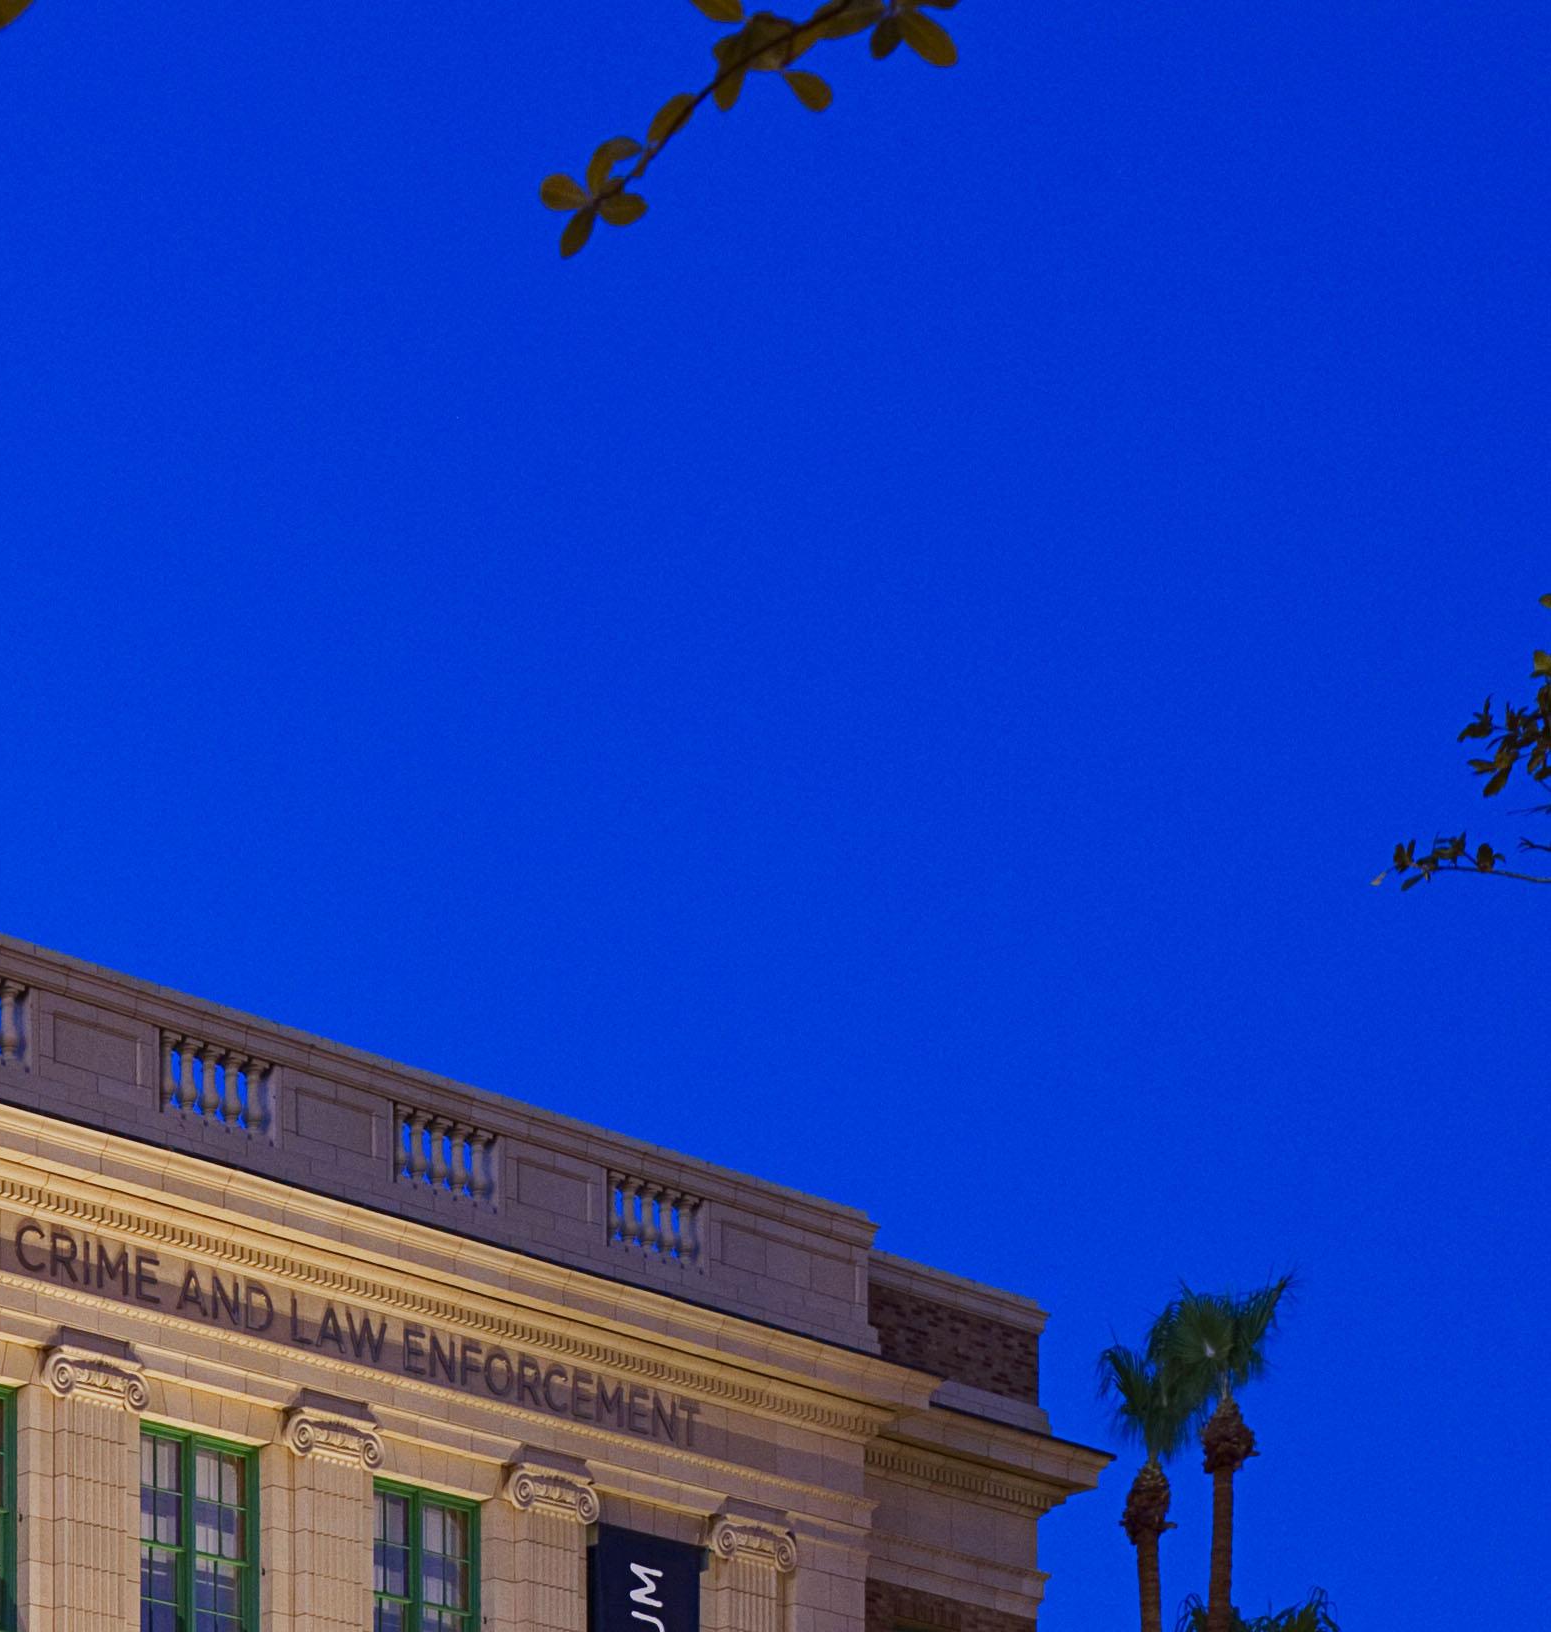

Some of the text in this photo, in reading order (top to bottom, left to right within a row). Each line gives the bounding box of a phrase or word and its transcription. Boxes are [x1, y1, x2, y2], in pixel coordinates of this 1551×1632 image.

[14, 1225, 160, 1303] CRIME
[177, 1269, 274, 1333] AND
[289, 1293, 388, 1363] LAW
[403, 1328, 701, 1446] ENFORCEMENT
